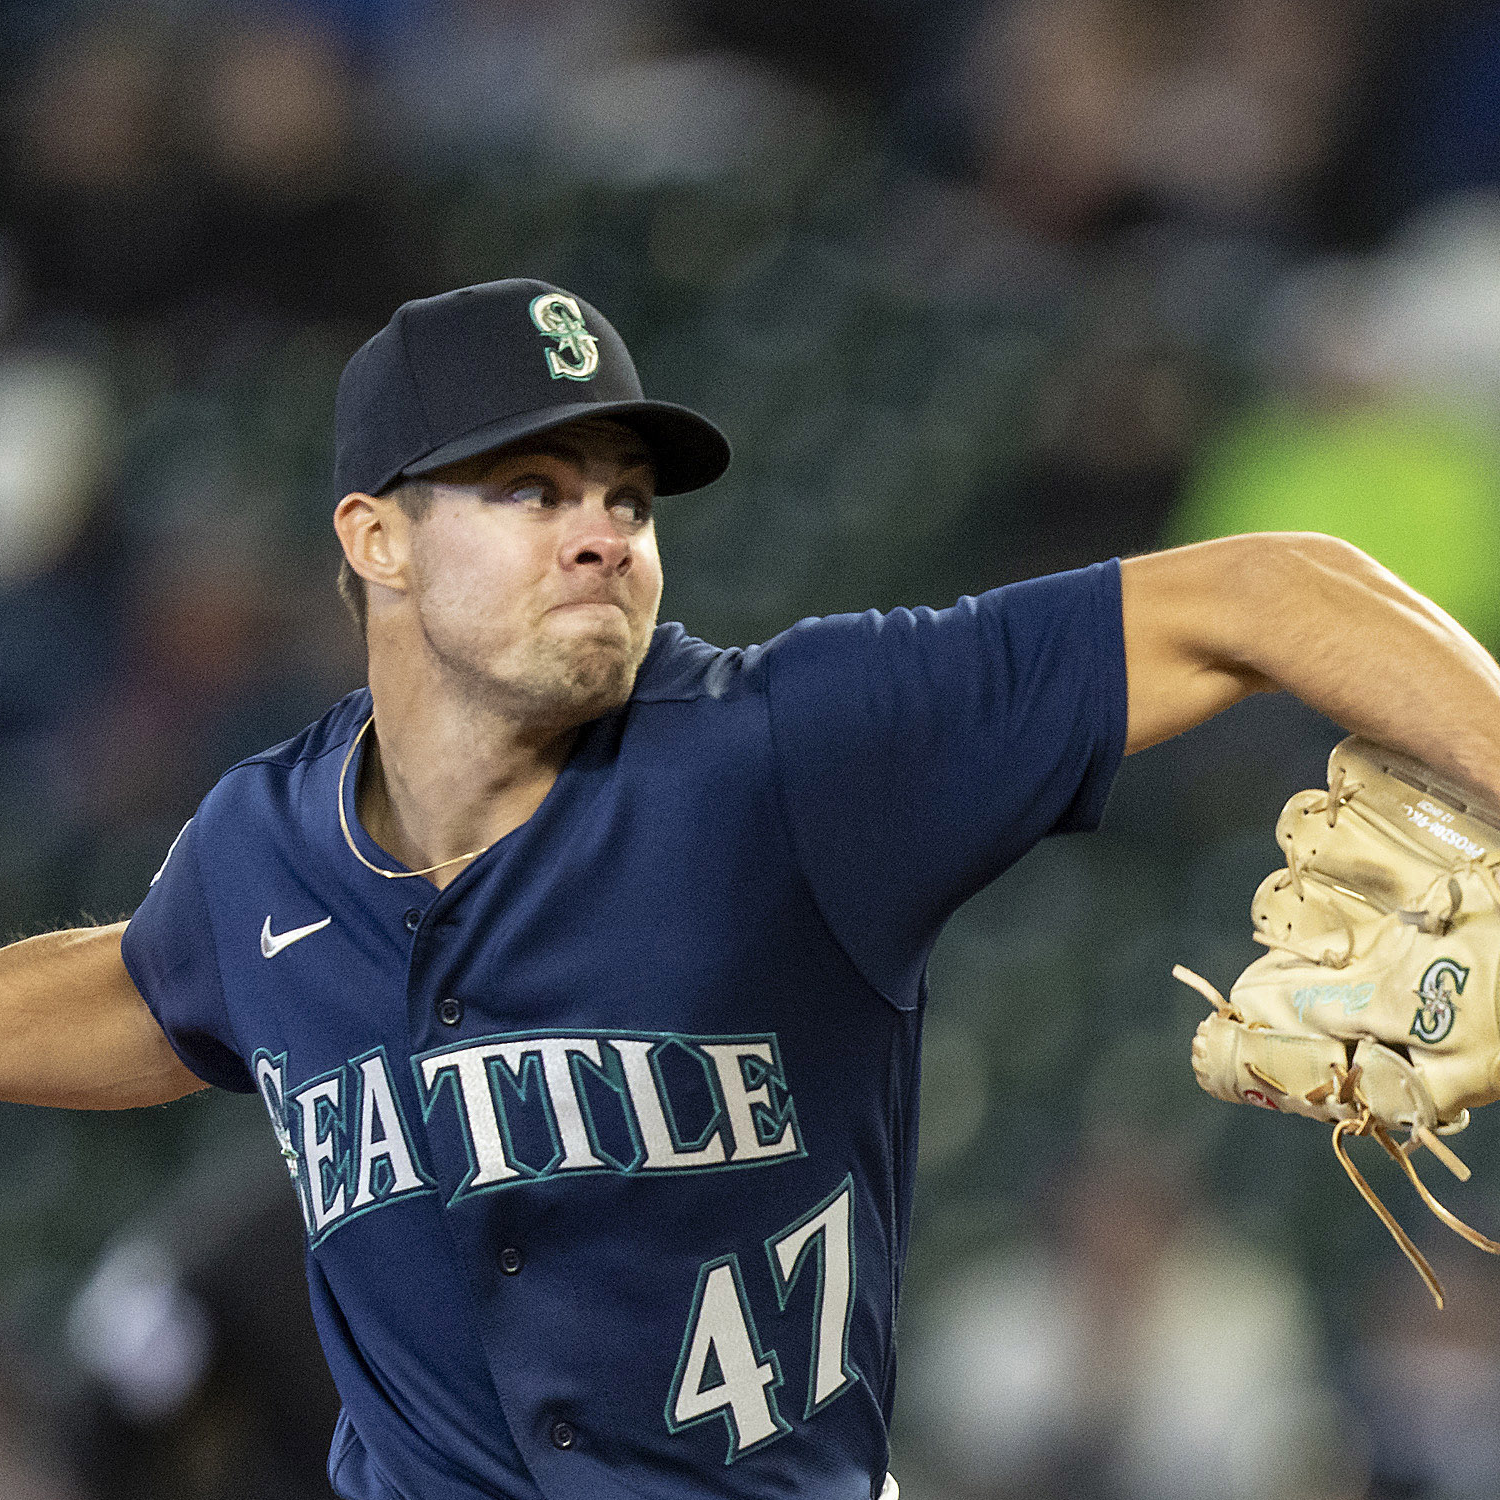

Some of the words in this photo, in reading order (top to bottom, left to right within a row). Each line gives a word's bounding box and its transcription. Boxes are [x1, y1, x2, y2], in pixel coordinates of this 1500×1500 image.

[529, 293, 599, 381] S
[253, 1028, 809, 1250] SEATTLE
[665, 1172, 860, 1465] 47
